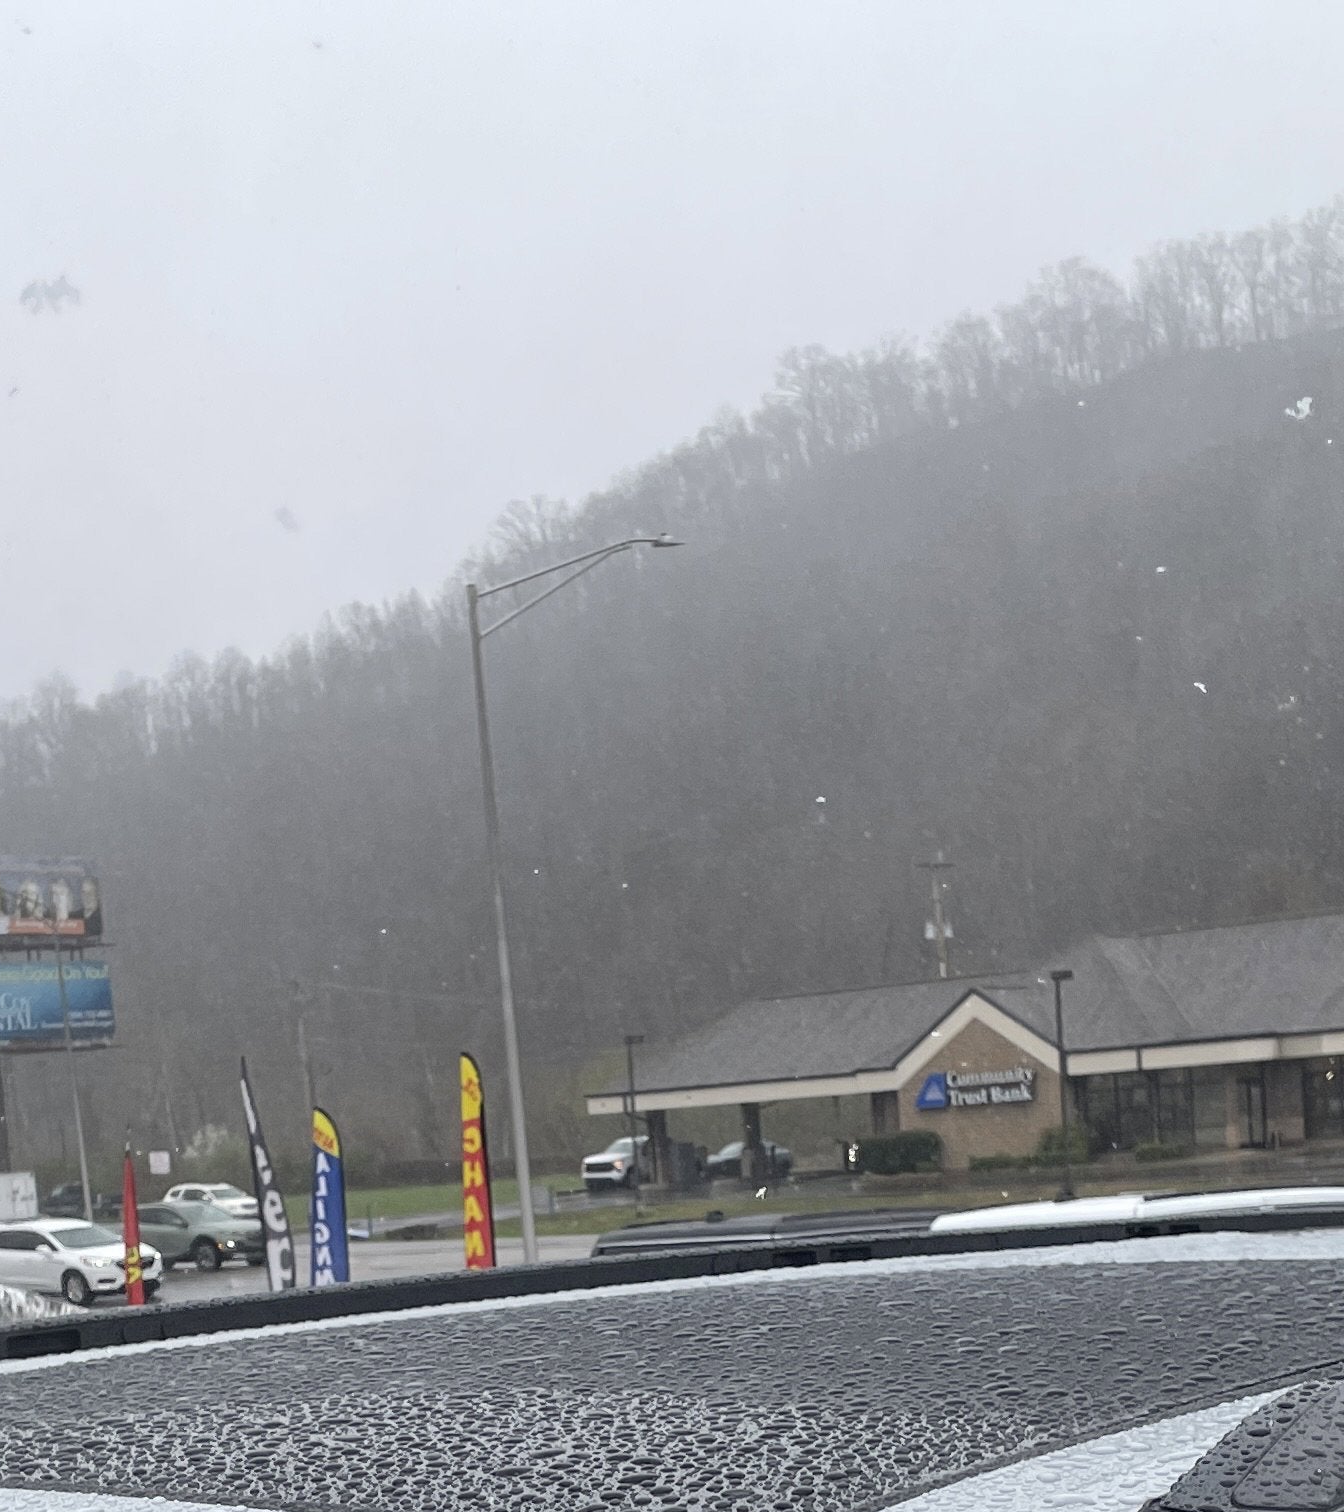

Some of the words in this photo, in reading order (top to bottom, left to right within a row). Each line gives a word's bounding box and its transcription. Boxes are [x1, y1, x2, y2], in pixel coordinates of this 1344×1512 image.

[946, 1067, 1034, 1088] Community
[947, 1088, 988, 1106] Trust
[990, 1083, 1033, 1104] Bank
